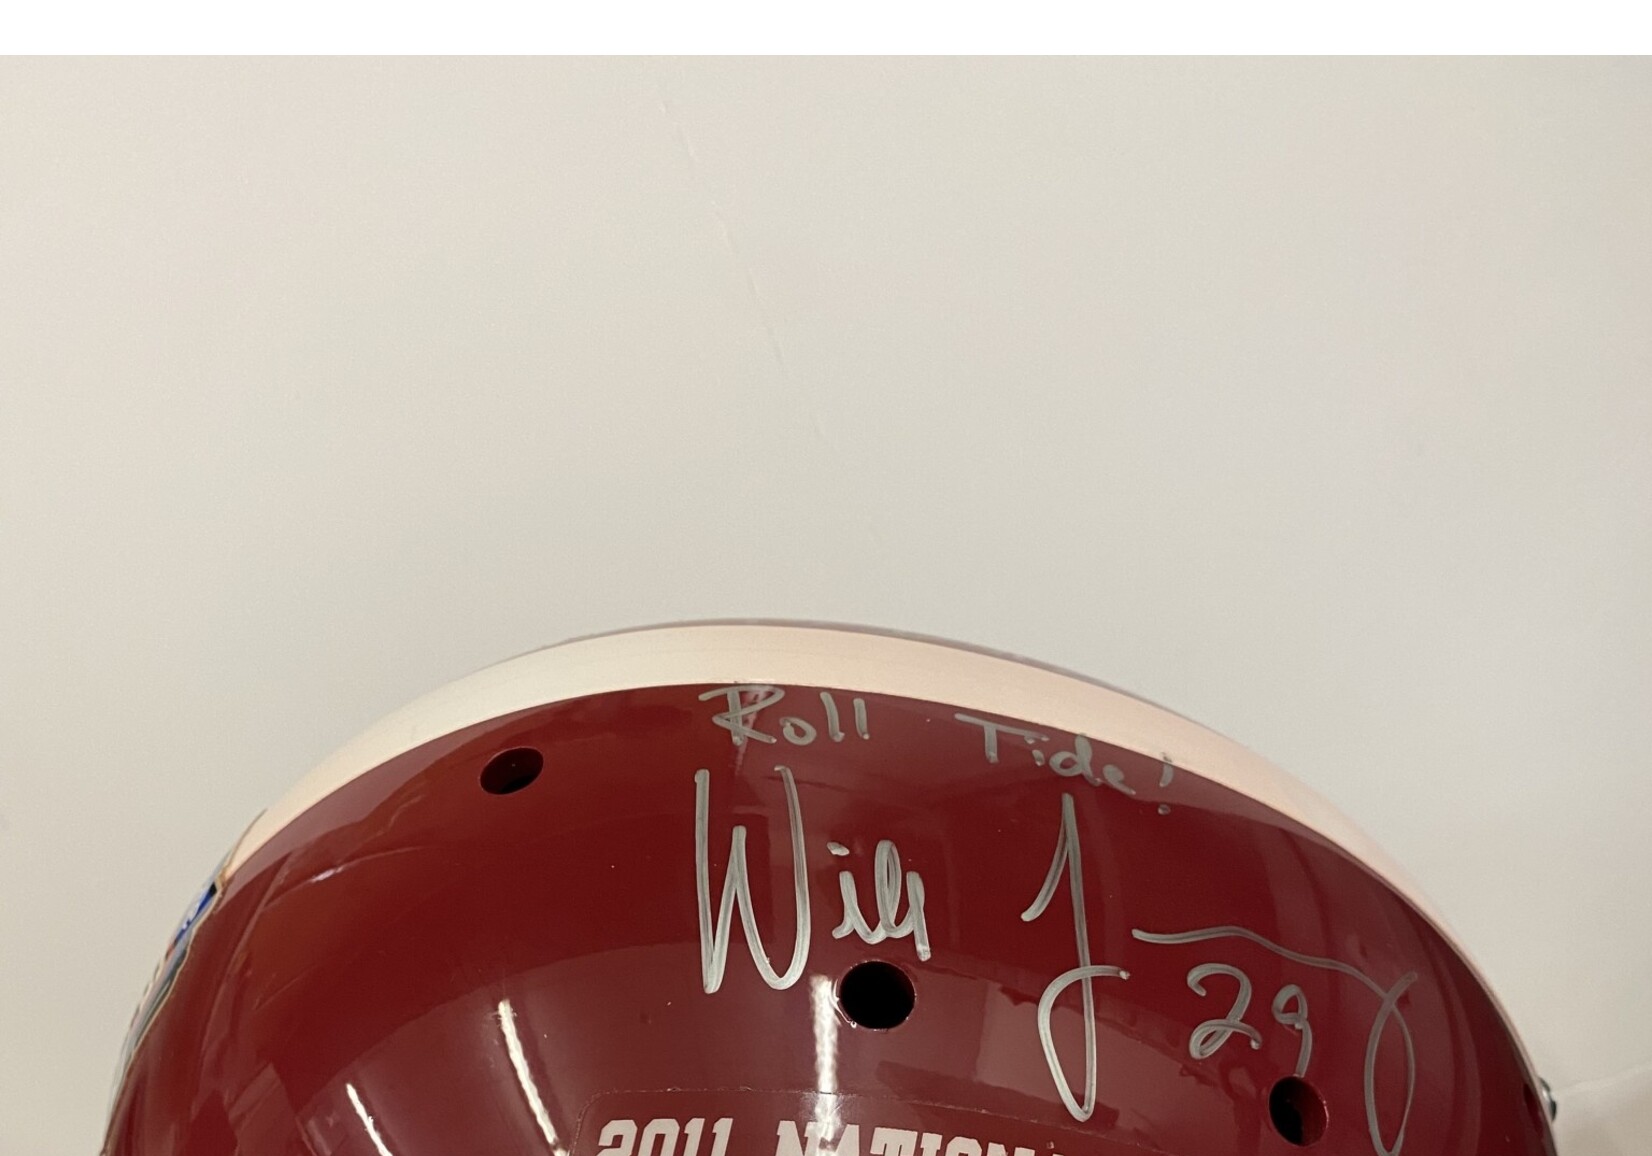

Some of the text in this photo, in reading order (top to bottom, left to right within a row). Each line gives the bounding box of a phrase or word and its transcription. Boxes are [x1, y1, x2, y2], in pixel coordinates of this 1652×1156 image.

[699, 684, 1176, 815] Roll Tide!
[1187, 963, 1314, 1078] 29
